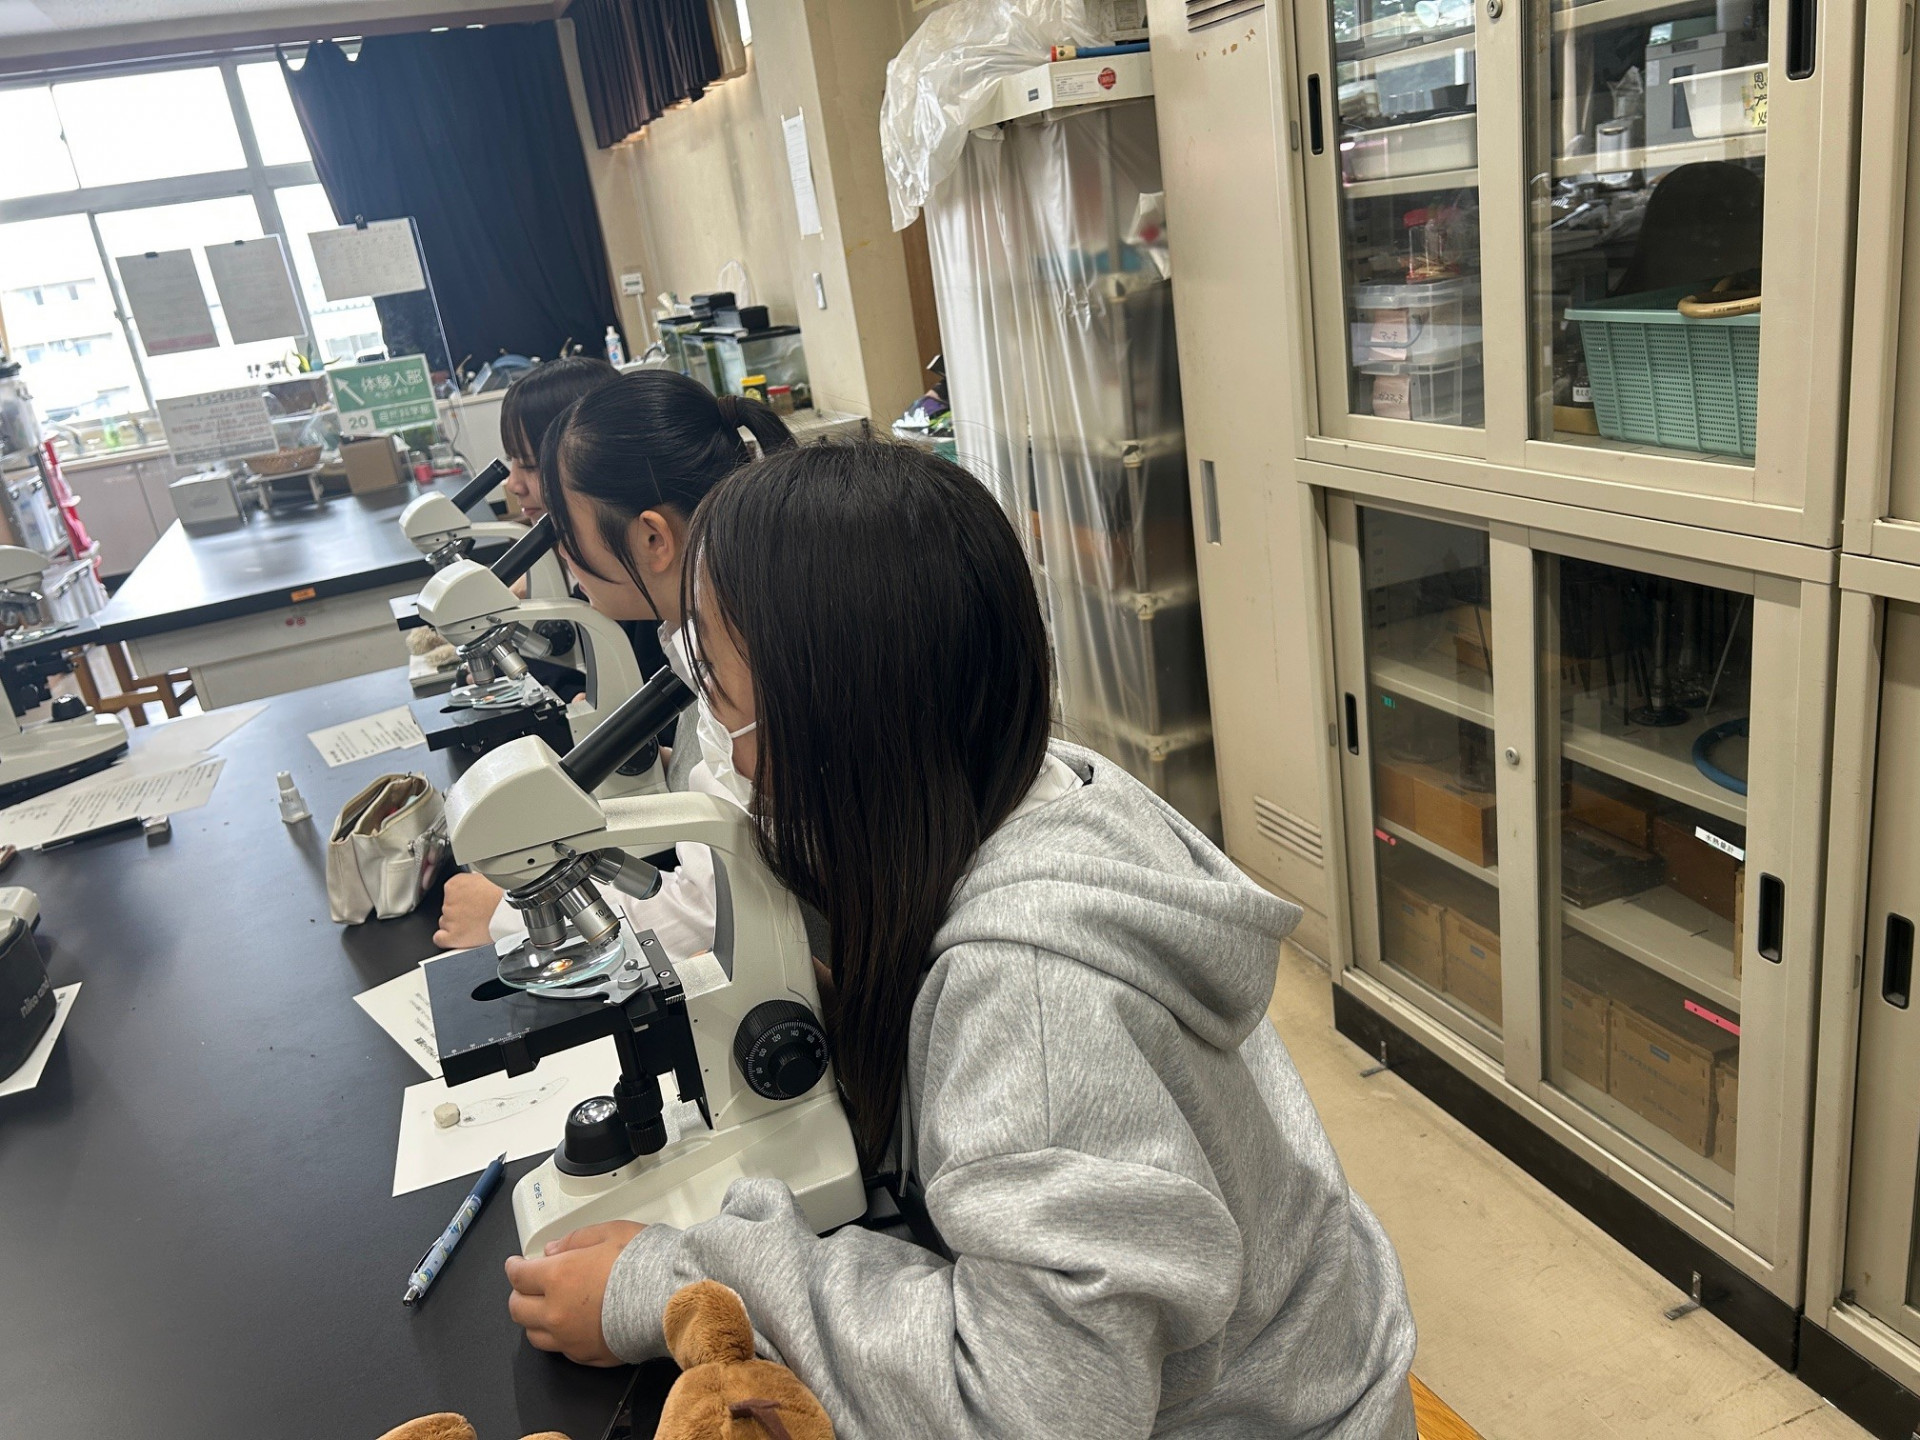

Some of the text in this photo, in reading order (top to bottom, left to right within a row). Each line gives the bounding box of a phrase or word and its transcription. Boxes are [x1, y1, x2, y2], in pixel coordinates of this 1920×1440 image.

[361, 369, 423, 393] 体験入部
[348, 415, 368, 430] 20
